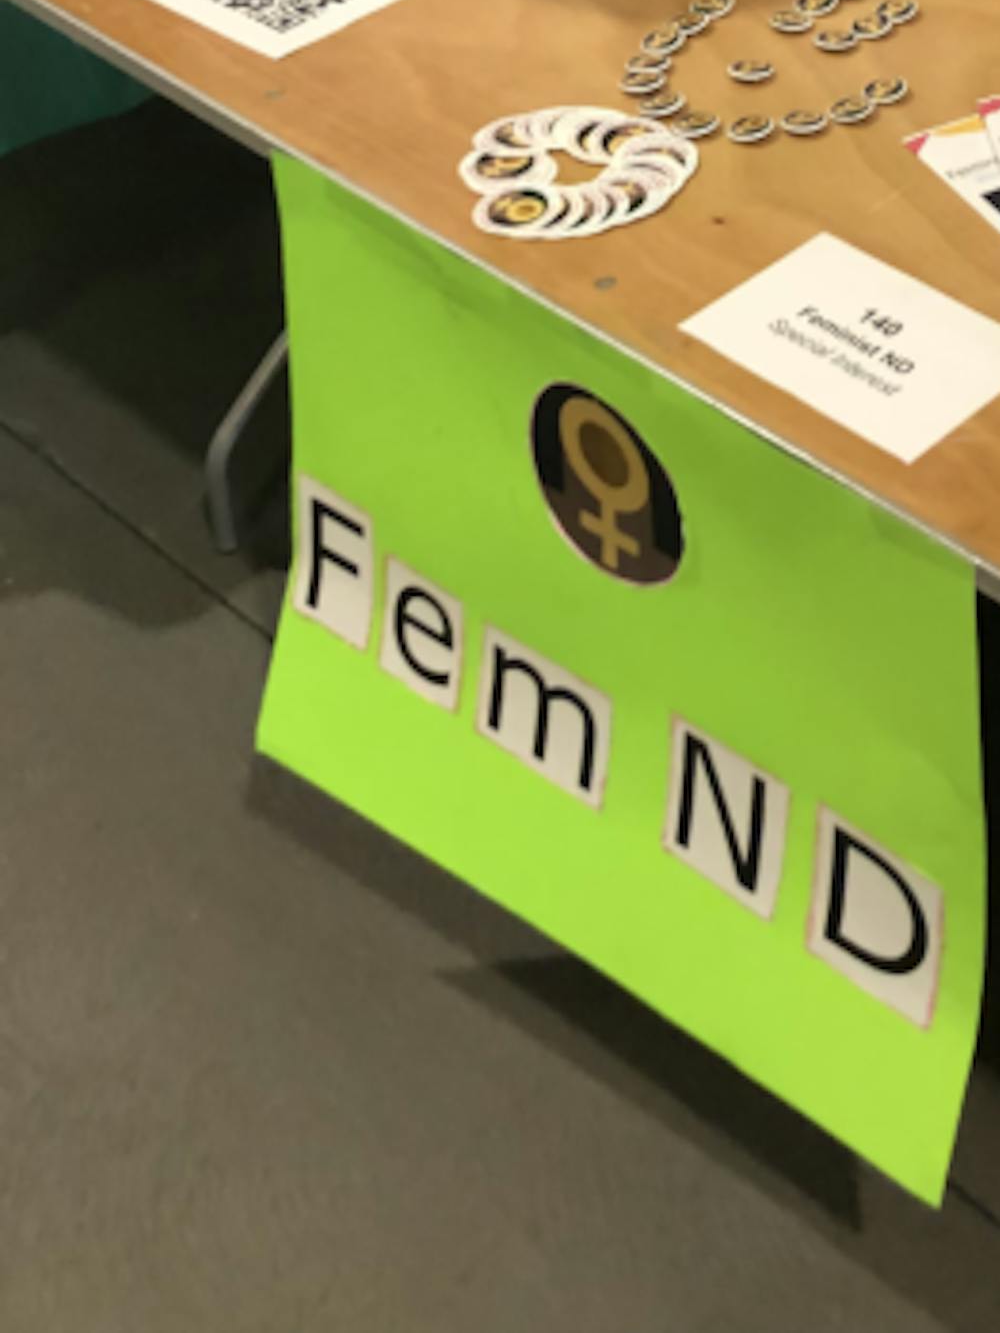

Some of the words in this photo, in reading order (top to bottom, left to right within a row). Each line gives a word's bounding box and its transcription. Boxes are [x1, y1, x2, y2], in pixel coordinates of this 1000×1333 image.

[797, 305, 880, 359] Feminist
[880, 350, 915, 375] ND
[859, 307, 903, 337] 140
[306, 498, 596, 793] Fem
[675, 729, 930, 976] ND
